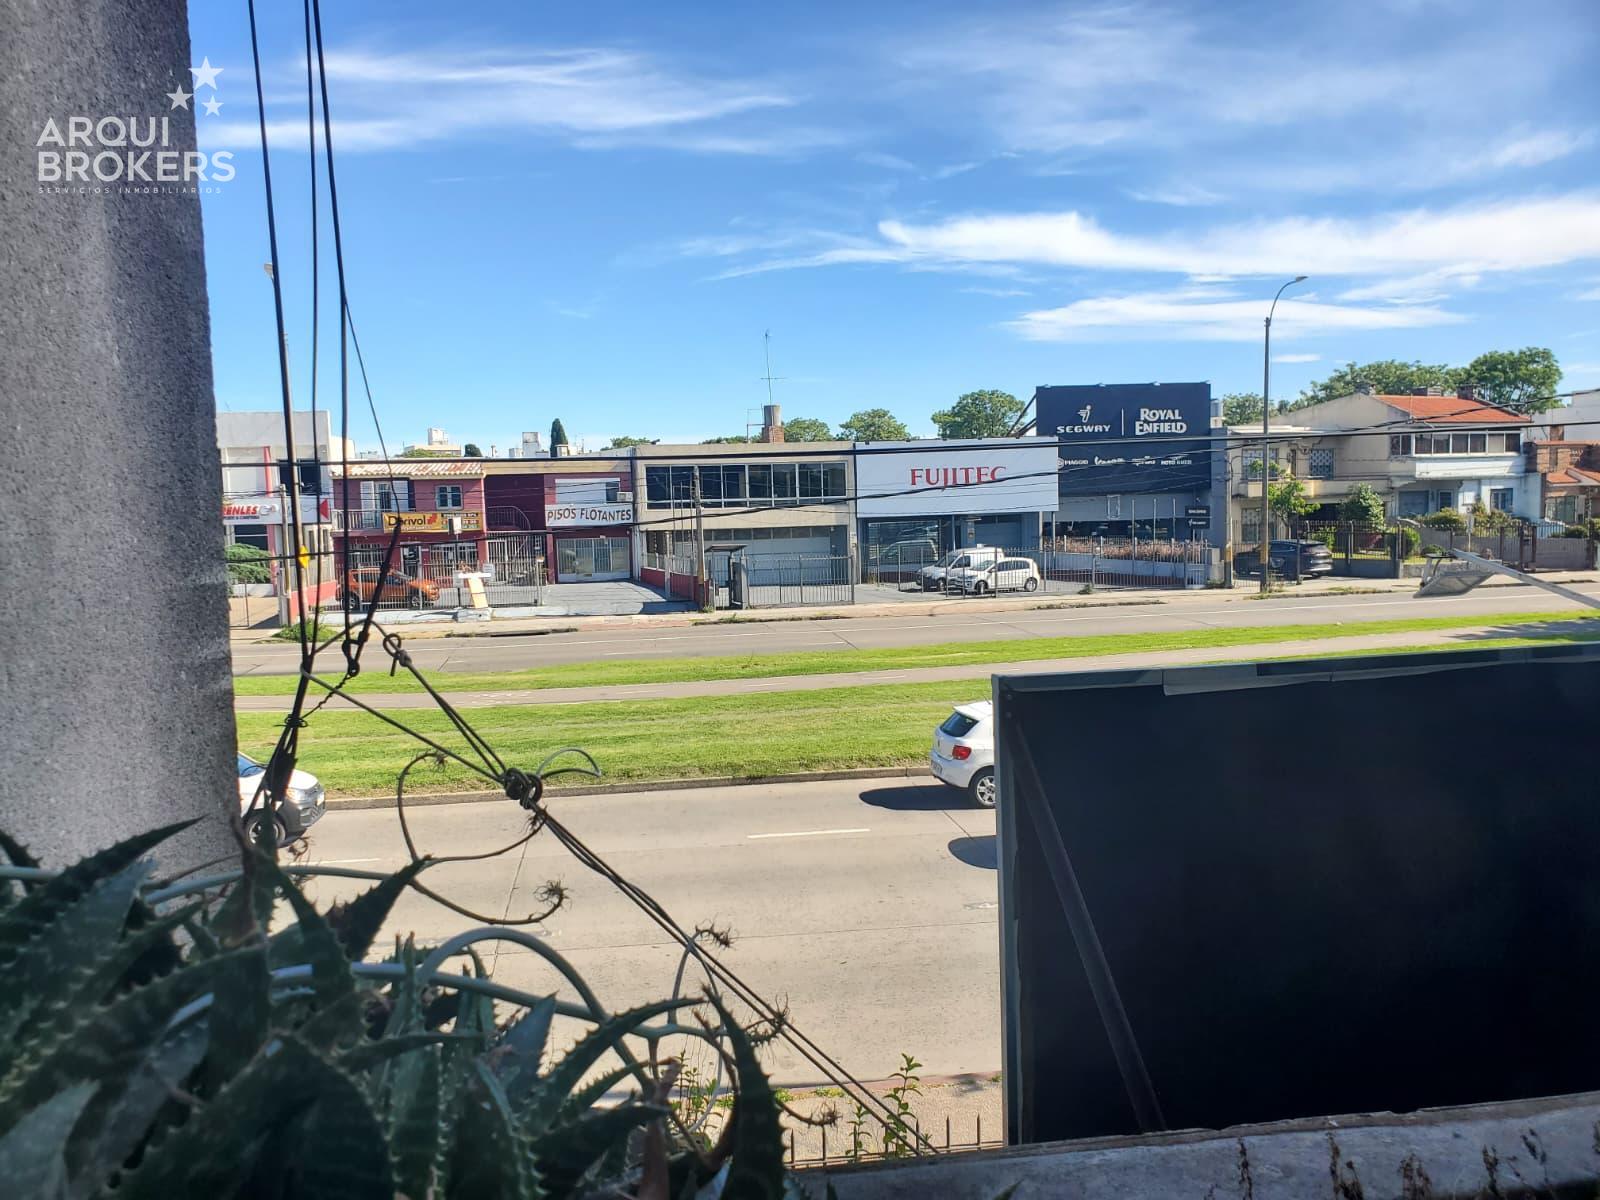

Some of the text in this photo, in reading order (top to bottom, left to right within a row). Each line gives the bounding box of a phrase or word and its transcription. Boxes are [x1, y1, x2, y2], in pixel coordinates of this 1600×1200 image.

[1140, 408, 1182, 422] ROYAL
[1056, 424, 1111, 434] SEGWAY
[1135, 421, 1187, 436] ENFIELD
[910, 466, 1006, 489] FUJITEC
[547, 508, 631, 522] PISOS FLOTANTES
